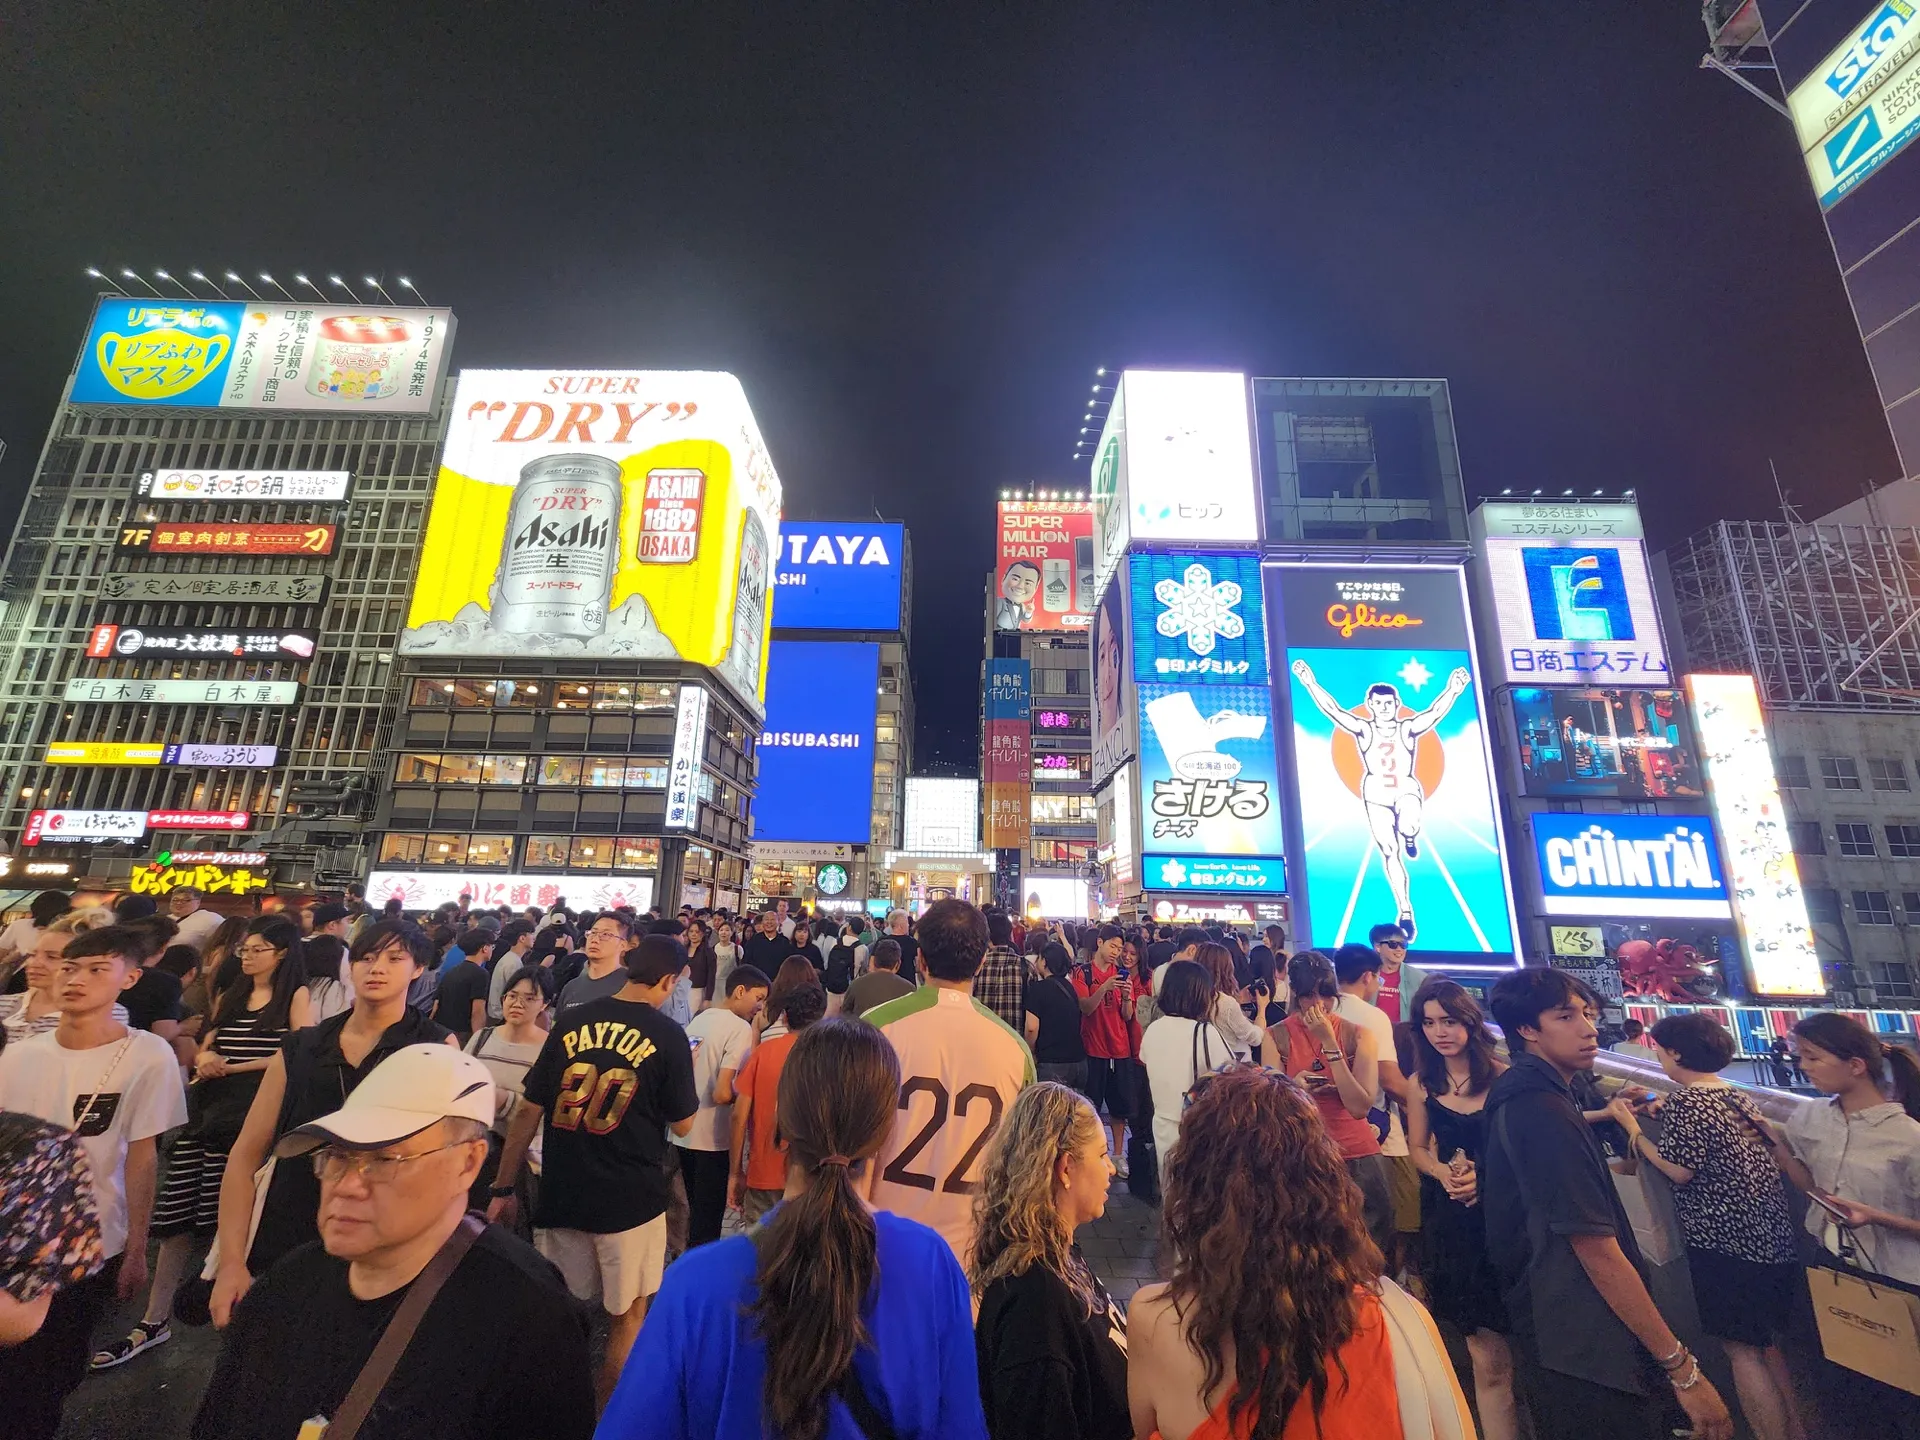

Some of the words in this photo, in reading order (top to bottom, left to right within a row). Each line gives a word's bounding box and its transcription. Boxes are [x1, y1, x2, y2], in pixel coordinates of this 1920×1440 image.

[1830, 99, 1853, 122] STA
[1856, 50, 1910, 98] TRAVEL
[126, 341, 203, 360] リブふわ
[284, 309, 314, 380] 実績と信頼の
[232, 331, 259, 391] 大木ヘルスケア
[407, 314, 436, 397] 1974年発売
[117, 363, 196, 387] マスク
[543, 376, 641, 395] SUPER
[138, 472, 153, 495] 8F
[552, 487, 587, 495] SUPER
[645, 475, 700, 499] ASAHI
[643, 508, 697, 531] 1889
[1003, 515, 1063, 529] SUPER
[1521, 506, 1599, 519] 夢ある住まい
[121, 529, 152, 545] 7F
[514, 513, 609, 550] Asahi
[1003, 530, 1070, 543] MILLION
[1511, 522, 1617, 536] エステムシリーズ
[157, 530, 251, 546] 個室肉割烹
[300, 527, 329, 552] 刀
[640, 535, 691, 557] OSAKA
[545, 553, 569, 568] 生
[1003, 545, 1048, 558] HAIR
[142, 579, 280, 597] 完全個室居酒屋
[526, 581, 583, 591] スーパードライ
[1336, 582, 1405, 592] すこやかな毎日、
[1342, 591, 1401, 602] ゆたかな人生
[1327, 603, 1424, 638] Glico
[94, 628, 111, 655] 5F
[176, 633, 240, 653] 大牧場
[1155, 657, 1250, 675] 雪印メグミルク
[1510, 647, 1668, 673] 日商エステム
[72, 680, 89, 689] 4F
[993, 674, 1022, 687] 龍角散
[88, 681, 157, 702] 白木屋
[204, 682, 273, 703] 白木屋
[1040, 711, 1069, 728] 焼肉
[992, 735, 1022, 748] 龍角散
[164, 746, 177, 764] 3F
[1043, 754, 1068, 768] 力丸
[1196, 761, 1222, 771] 北海道
[991, 799, 1021, 813] 龍角散
[1151, 778, 1270, 820] さける
[27, 813, 42, 841] 2F
[1152, 818, 1199, 840] チーズ
[170, 852, 267, 865] ハンバーグレストラン
[130, 864, 268, 895] びっくりドンキー
[1190, 872, 1268, 887] 雪印メグミルク
[1562, 930, 1594, 952] くくる
[1711, 935, 1720, 954] 2F
[562, 1021, 658, 1069] PAYTON
[551, 1062, 640, 1136] 20
[882, 1075, 1004, 1196] 22
